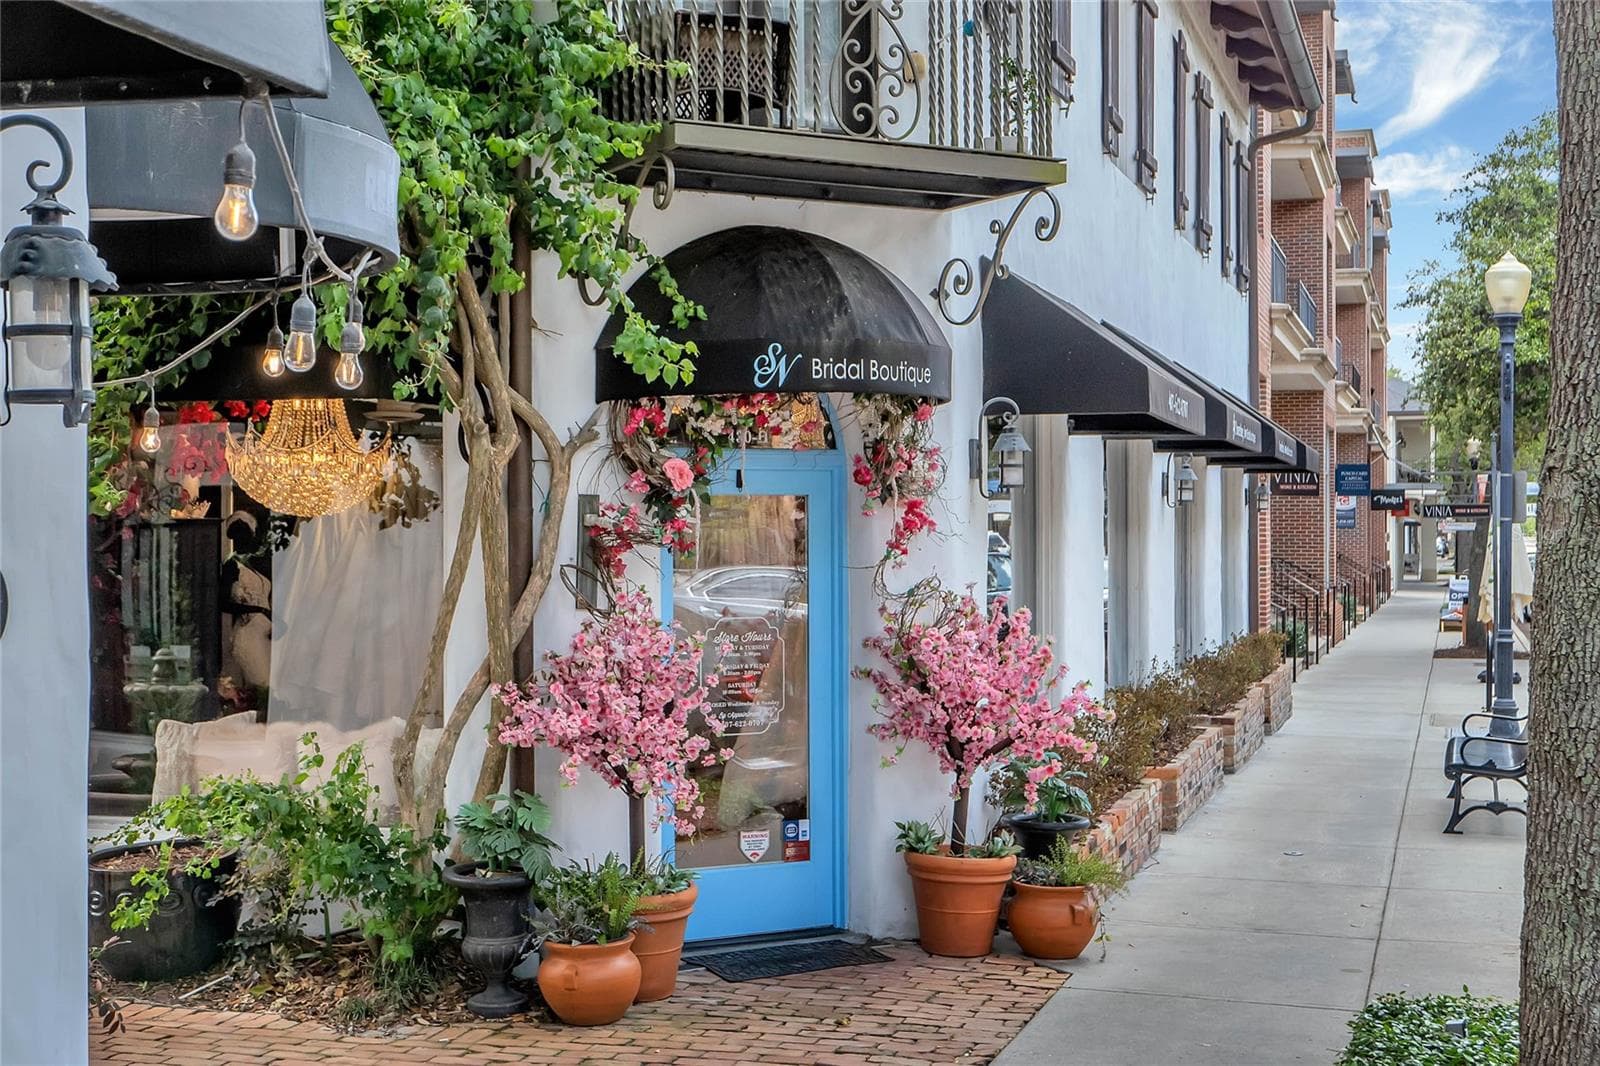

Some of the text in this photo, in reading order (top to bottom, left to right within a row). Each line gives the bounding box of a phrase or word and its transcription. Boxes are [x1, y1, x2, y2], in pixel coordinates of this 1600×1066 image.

[811, 358, 864, 380] Bridal
[869, 359, 931, 387] Boutique
[1425, 505, 1453, 517] VINIA
[713, 631, 775, 644] Store Hours
